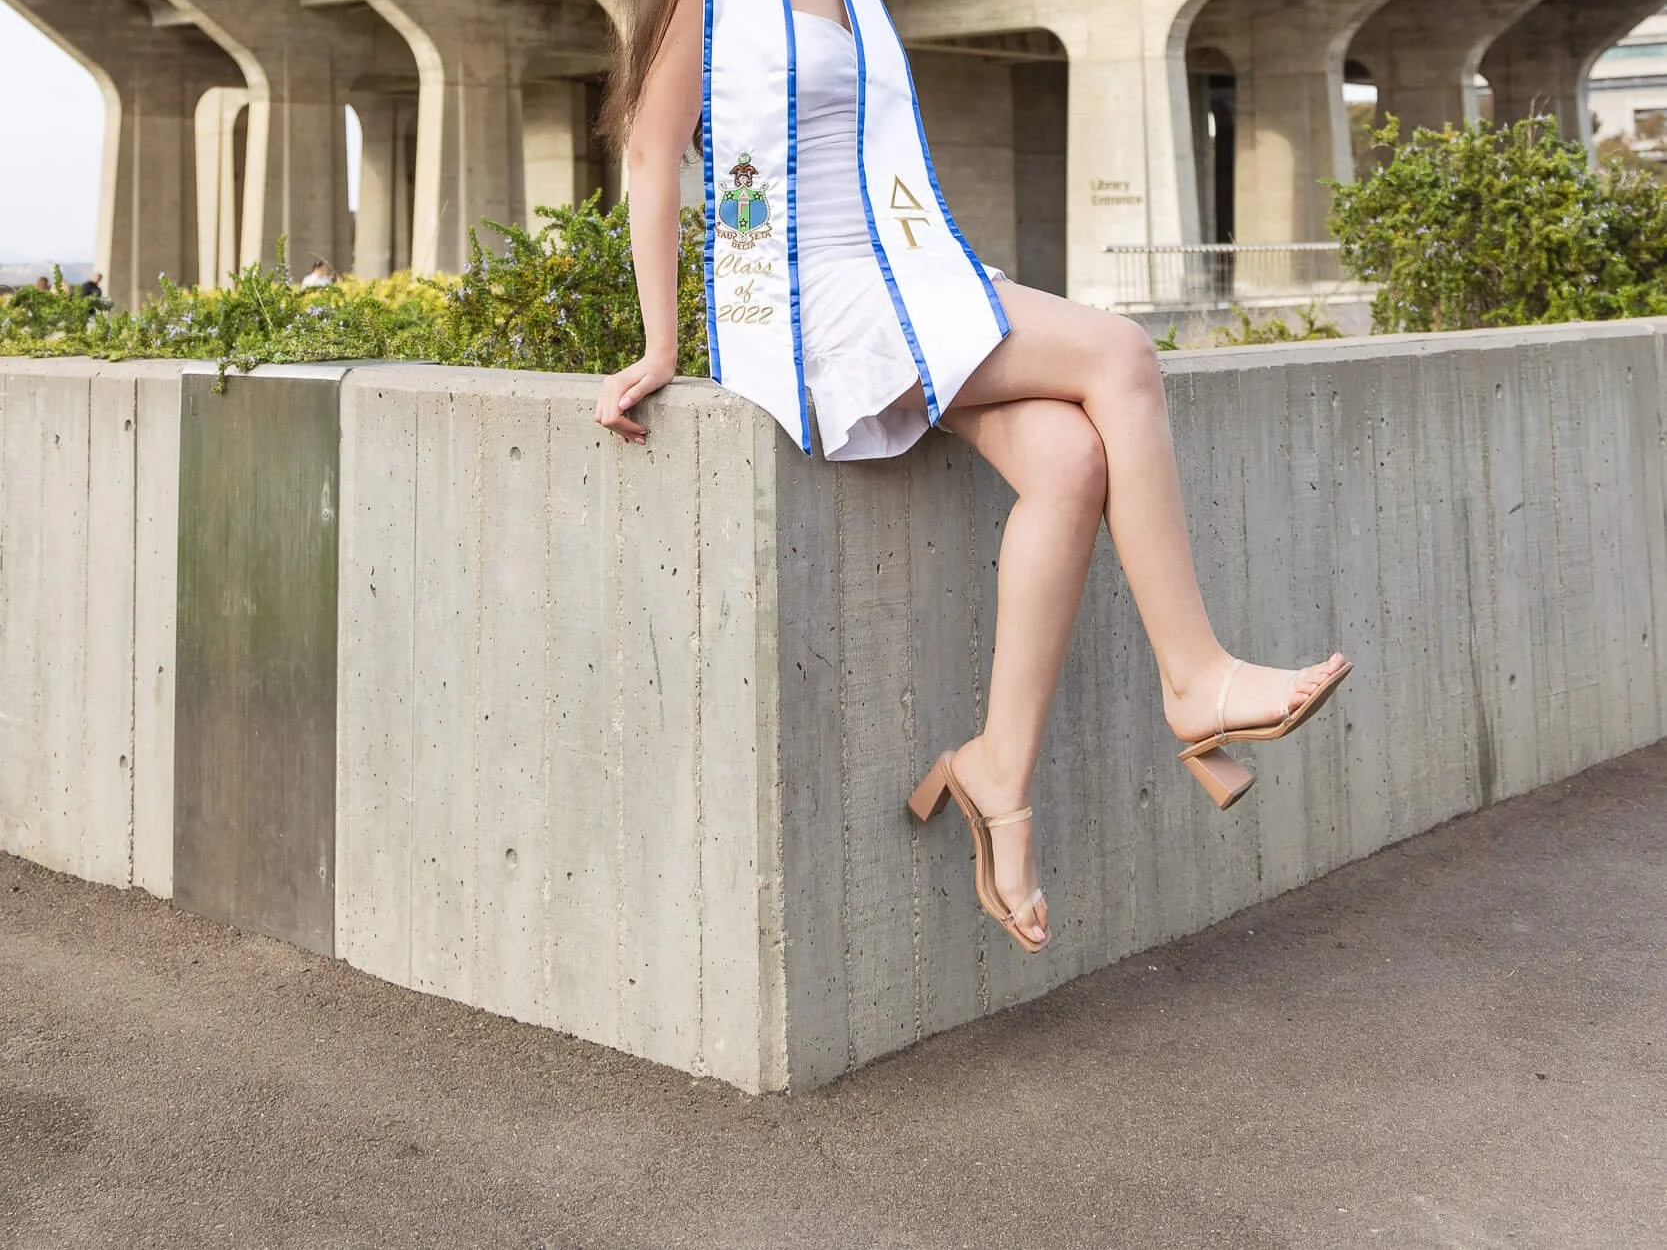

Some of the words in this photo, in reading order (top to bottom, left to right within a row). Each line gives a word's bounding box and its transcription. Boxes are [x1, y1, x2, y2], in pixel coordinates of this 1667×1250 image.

[1089, 178, 1130, 192] Library
[1091, 196, 1142, 206] Entrance
[716, 254, 773, 278] Class
[735, 279, 754, 304] of
[717, 305, 774, 324] 2022
